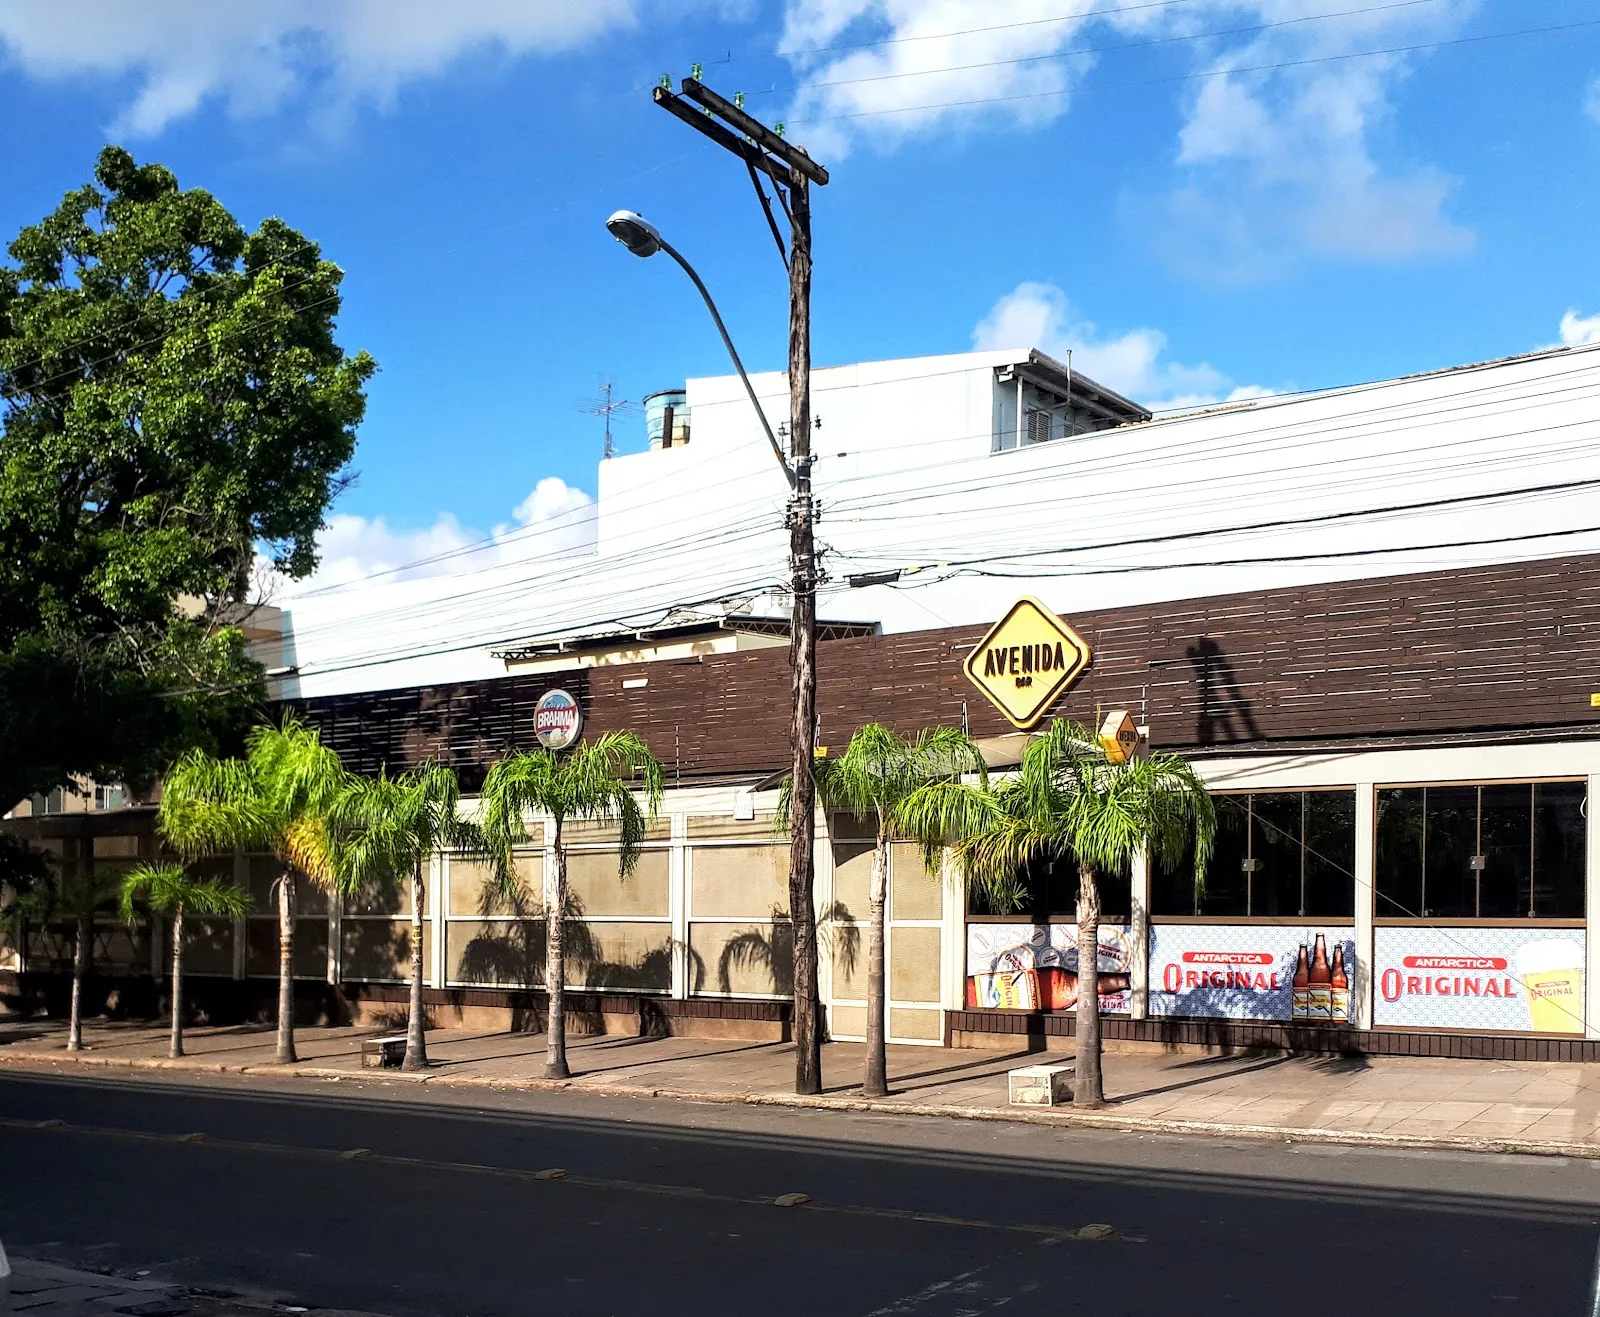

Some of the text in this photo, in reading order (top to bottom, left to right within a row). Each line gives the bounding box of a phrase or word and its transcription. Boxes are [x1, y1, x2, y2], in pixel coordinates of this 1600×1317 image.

[984, 641, 1065, 678] AVENIDA
[537, 709, 574, 729] BRAHMA
[1192, 953, 1263, 964] ANTARCTICA
[1415, 958, 1495, 968] ANTARCTICA
[1163, 963, 1282, 995] ORIGINAL
[1381, 968, 1518, 1003] ORIGINAL
[1531, 987, 1573, 1001] ORIGINAL
